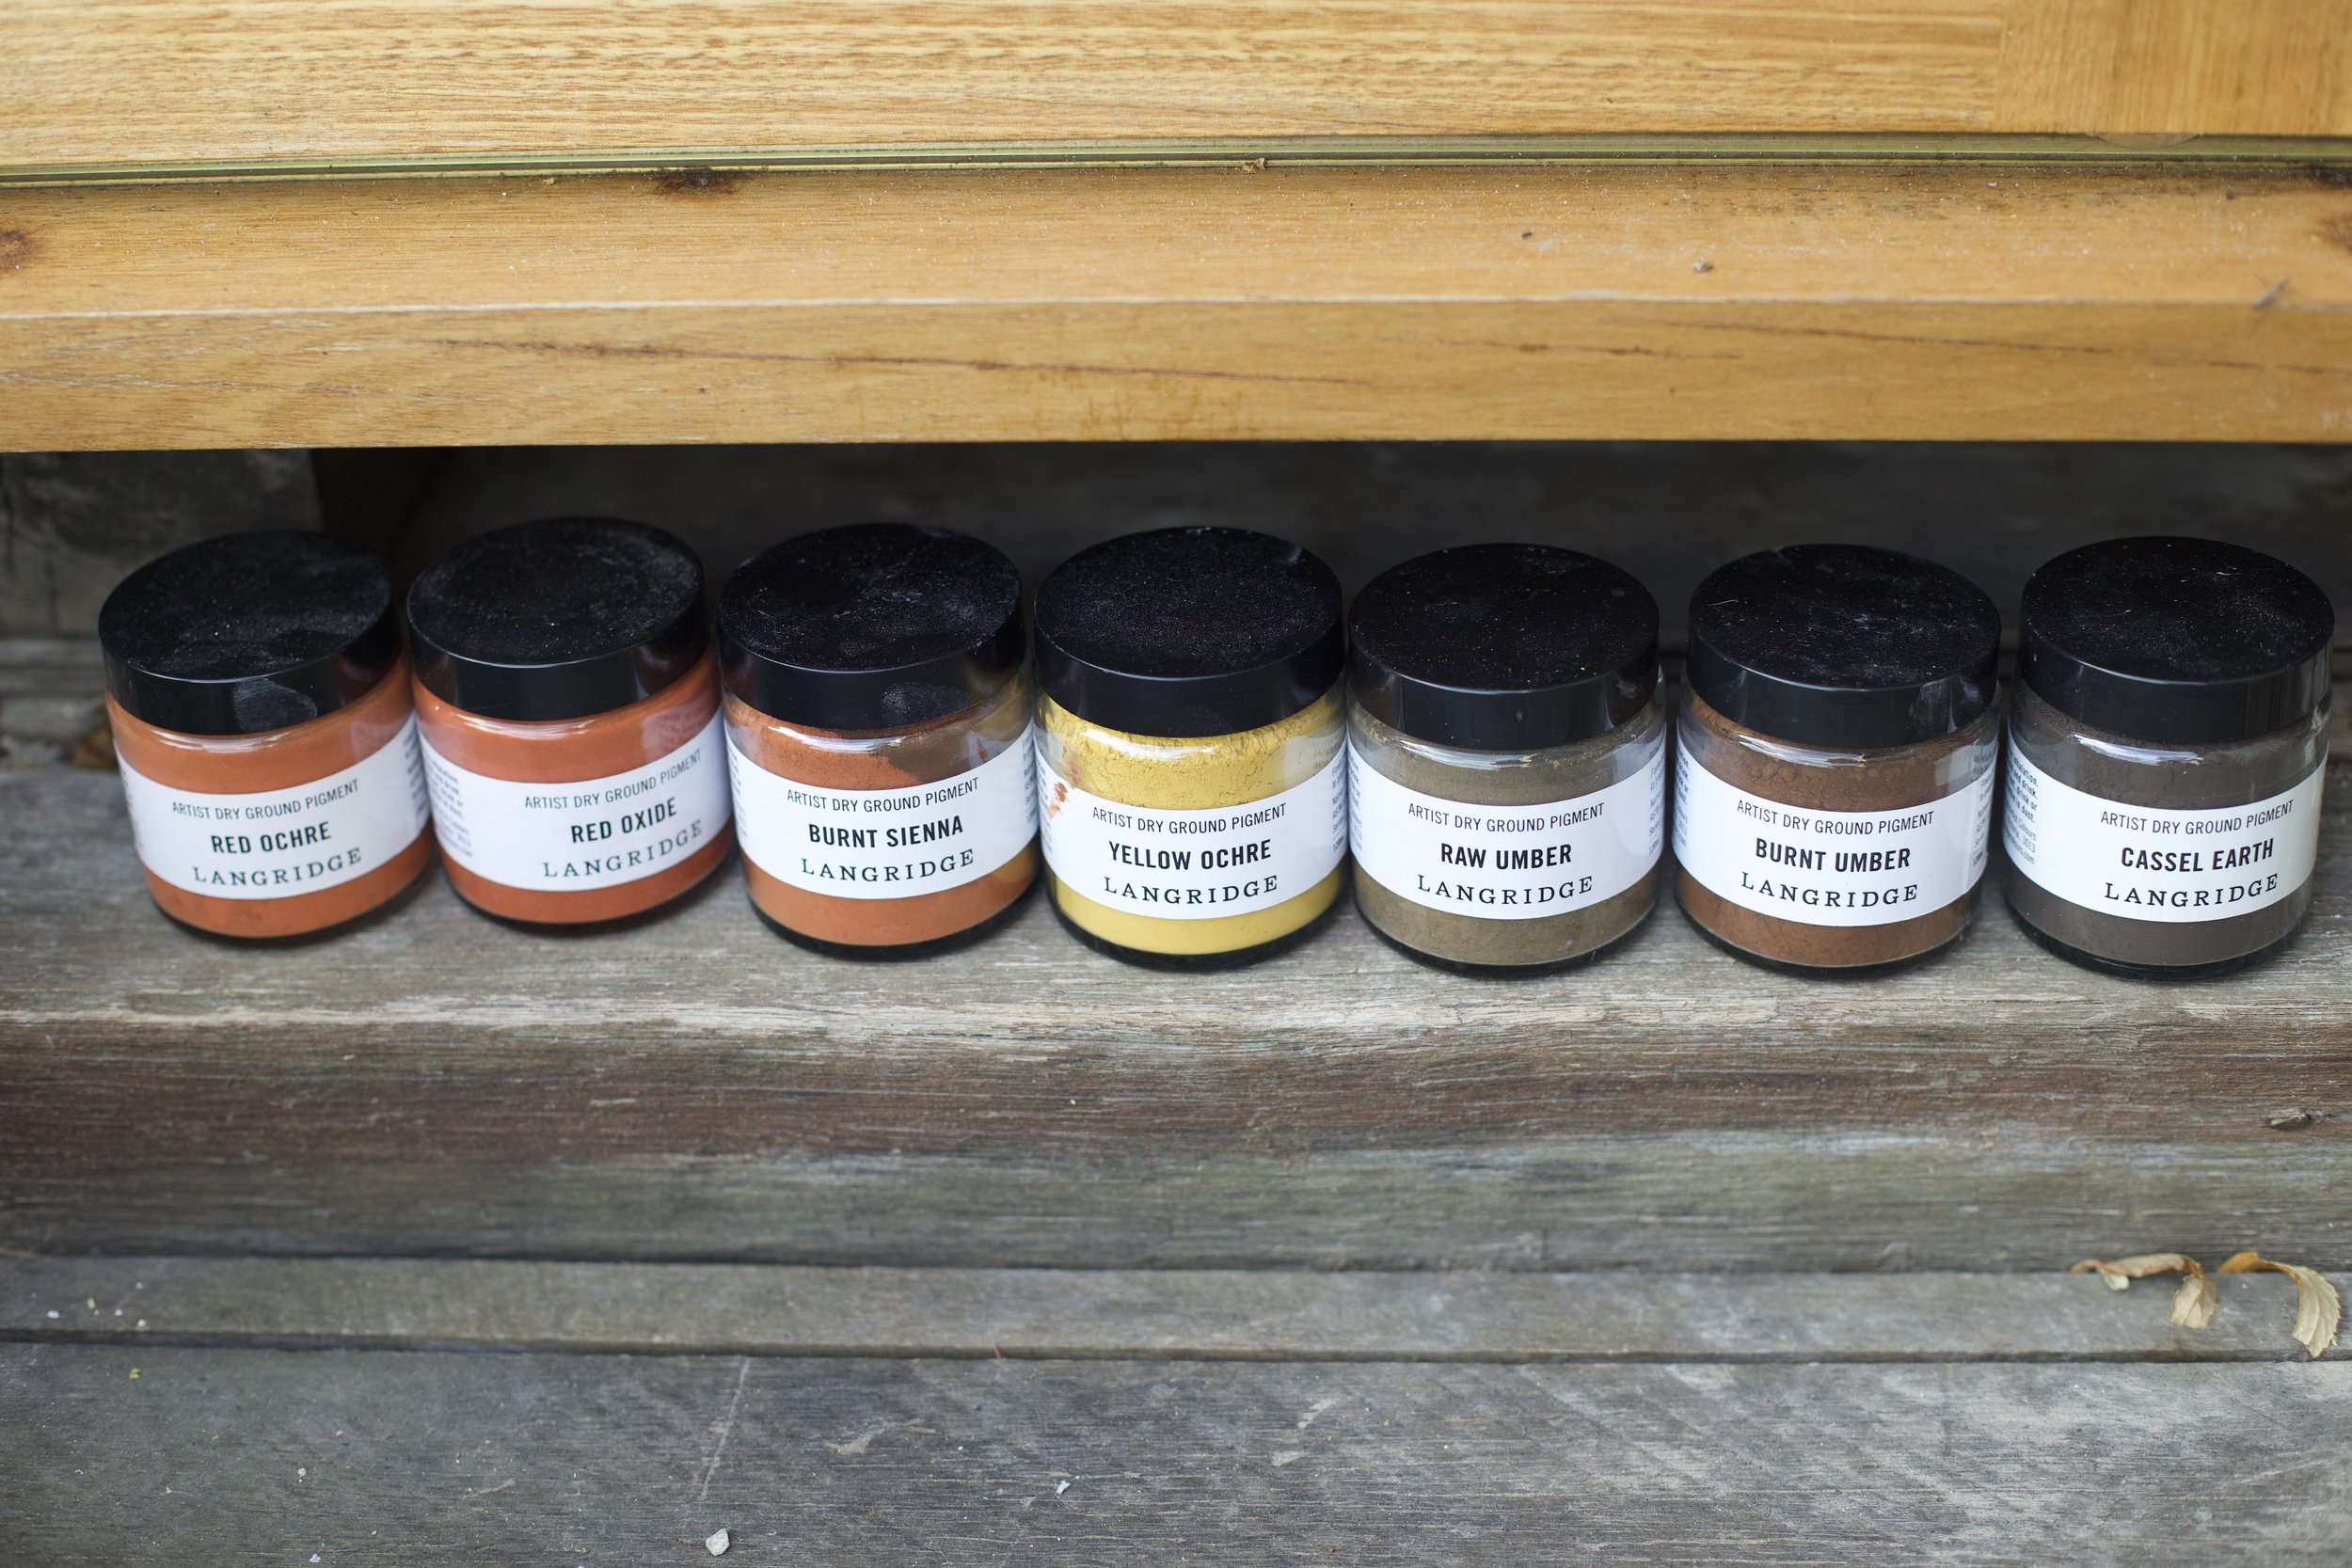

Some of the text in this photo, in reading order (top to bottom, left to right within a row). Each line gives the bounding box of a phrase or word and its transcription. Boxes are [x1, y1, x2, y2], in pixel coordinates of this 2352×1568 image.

[525, 750, 701, 809] ARTIST DRY GROUND PIGMENT
[787, 777, 978, 812] ARTIST DRY GROUND PIGMENT
[173, 779, 358, 820] ARTIST DRY GROUND PIGMENT
[2030, 801, 2038, 811] or
[571, 798, 676, 843] RED OXIDE
[809, 816, 962, 847] BURNT SIENNA
[1093, 801, 1286, 833] ARTIST DRY GROUND PIGMENT
[1408, 802, 1604, 832] ARTIST DRY GROUND PIGMENT
[1738, 800, 1933, 834] ARTIST DRY GROUND PIGMENT
[2101, 800, 2294, 834] ARTIST DRY GROUND PIGMENT
[211, 821, 330, 853] RED OCHRE
[543, 819, 703, 878] LANGRIDGE
[193, 847, 362, 886] LANGRIDGE
[802, 848, 974, 882] LANGRIDGE
[1109, 839, 1271, 870] YELLOW OCHRE
[1441, 843, 1571, 869] RAW UMBER
[1756, 838, 1910, 872] BURNT UMBER
[2122, 838, 2273, 872] CASSEL EARTH
[1104, 875, 1277, 904] LANGRIDGE
[1418, 875, 1592, 904] LANGRIDGE
[1741, 871, 1917, 908] LANGRIDGE
[2105, 873, 2278, 908] LANGRIDGE
